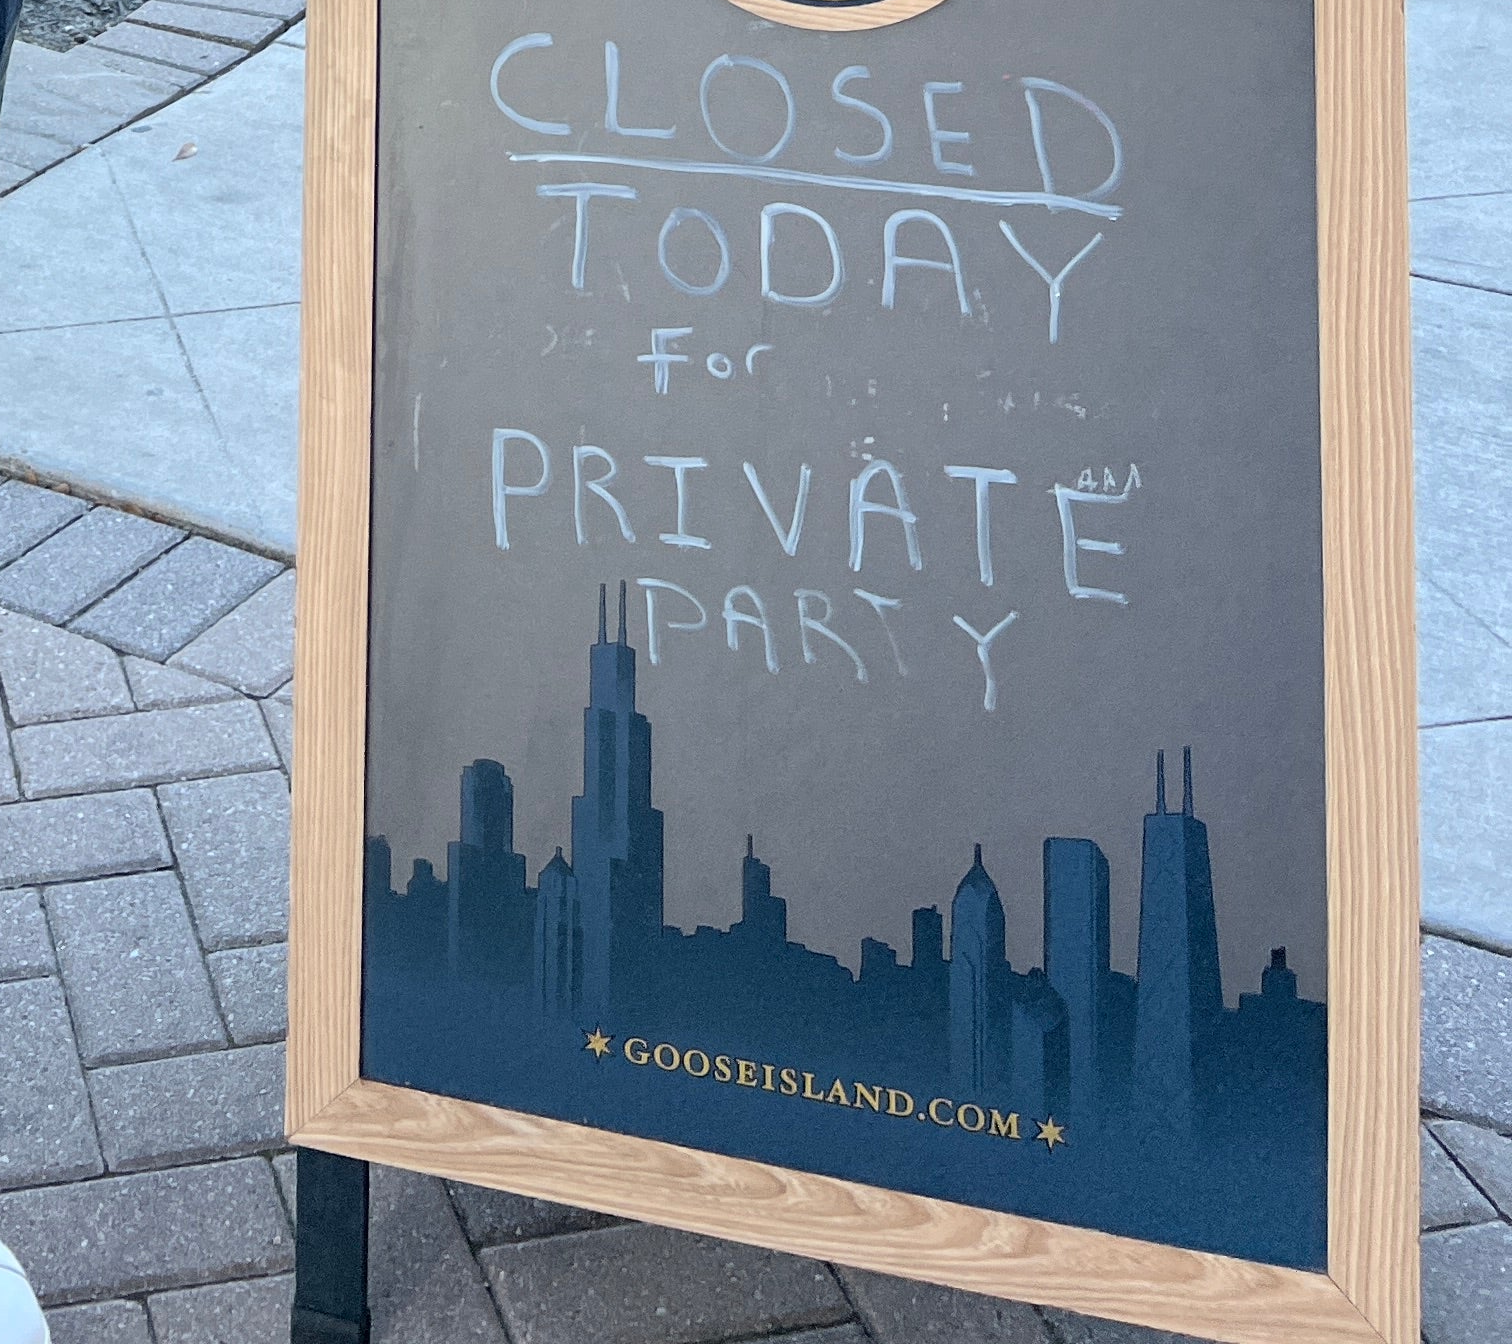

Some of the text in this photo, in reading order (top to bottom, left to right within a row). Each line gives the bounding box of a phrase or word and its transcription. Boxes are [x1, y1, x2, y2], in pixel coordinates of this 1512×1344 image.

[490, 32, 1124, 202] CLOSED
[536, 183, 1104, 345] TODAY
[491, 427, 1130, 605] PRIVATE
[635, 576, 1020, 711] PARTY
[622, 1036, 1022, 1140] GOOSEISLAND.COM
